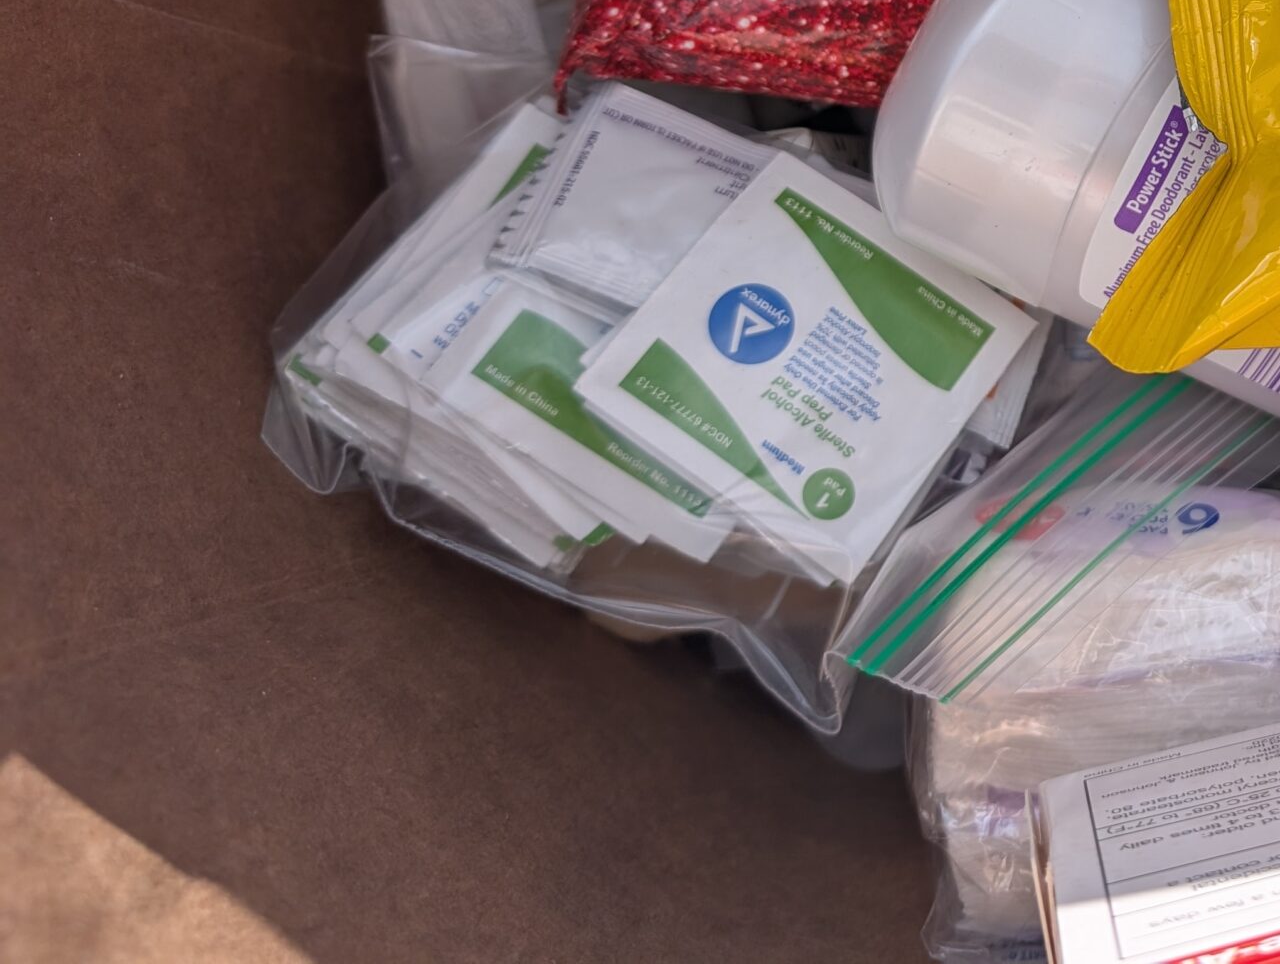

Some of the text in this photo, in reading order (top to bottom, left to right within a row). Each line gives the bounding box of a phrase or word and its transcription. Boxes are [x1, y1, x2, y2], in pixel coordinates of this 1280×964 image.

[1127, 167, 1162, 214] Power
[1103, 245, 1146, 299] Aluminum
[1136, 220, 1161, 248] Free
[1151, 156, 1196, 221] Deodorant
[785, 198, 983, 337] Made in China Reorder No. 1113
[741, 288, 791, 325] dynarex
[636, 377, 733, 448] NDC# 67777-121-13
[771, 376, 833, 421] Prep Pad
[485, 364, 514, 386] Made
[515, 385, 527, 395] in
[526, 391, 558, 416] China
[607, 442, 650, 473] Reorder
[650, 470, 669, 487] No.
[760, 388, 855, 458] Sterile Alcohol
[762, 440, 804, 475] Medium
[816, 492, 830, 508] 1
[822, 477, 846, 496] Pad
[1107, 788, 1232, 820] monostearate,
